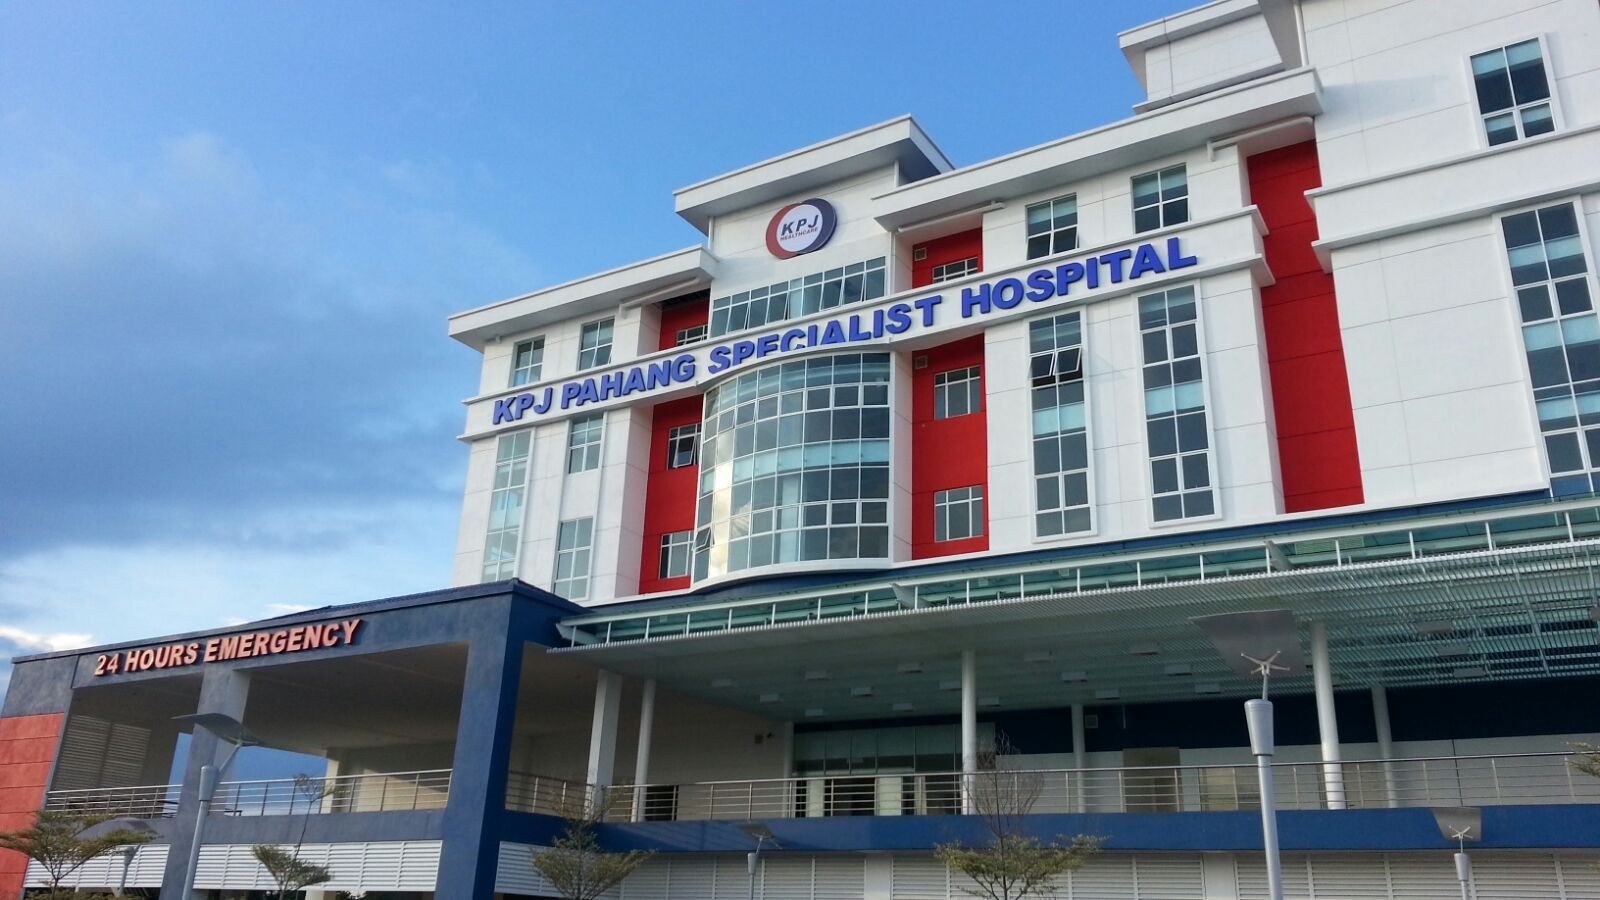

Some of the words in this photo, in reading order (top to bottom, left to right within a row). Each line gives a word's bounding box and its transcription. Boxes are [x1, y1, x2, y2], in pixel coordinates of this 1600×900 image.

[780, 227, 818, 241] HEALTHCARE
[781, 215, 819, 236] KPJ
[492, 387, 553, 425] KPJ
[561, 355, 696, 410] PAHANG
[708, 295, 942, 375] SPECIALIST
[961, 237, 1197, 318] HOSPITAL
[94, 654, 119, 677] 24
[124, 642, 200, 673] HOURS
[203, 619, 363, 663] EMERGENCY
